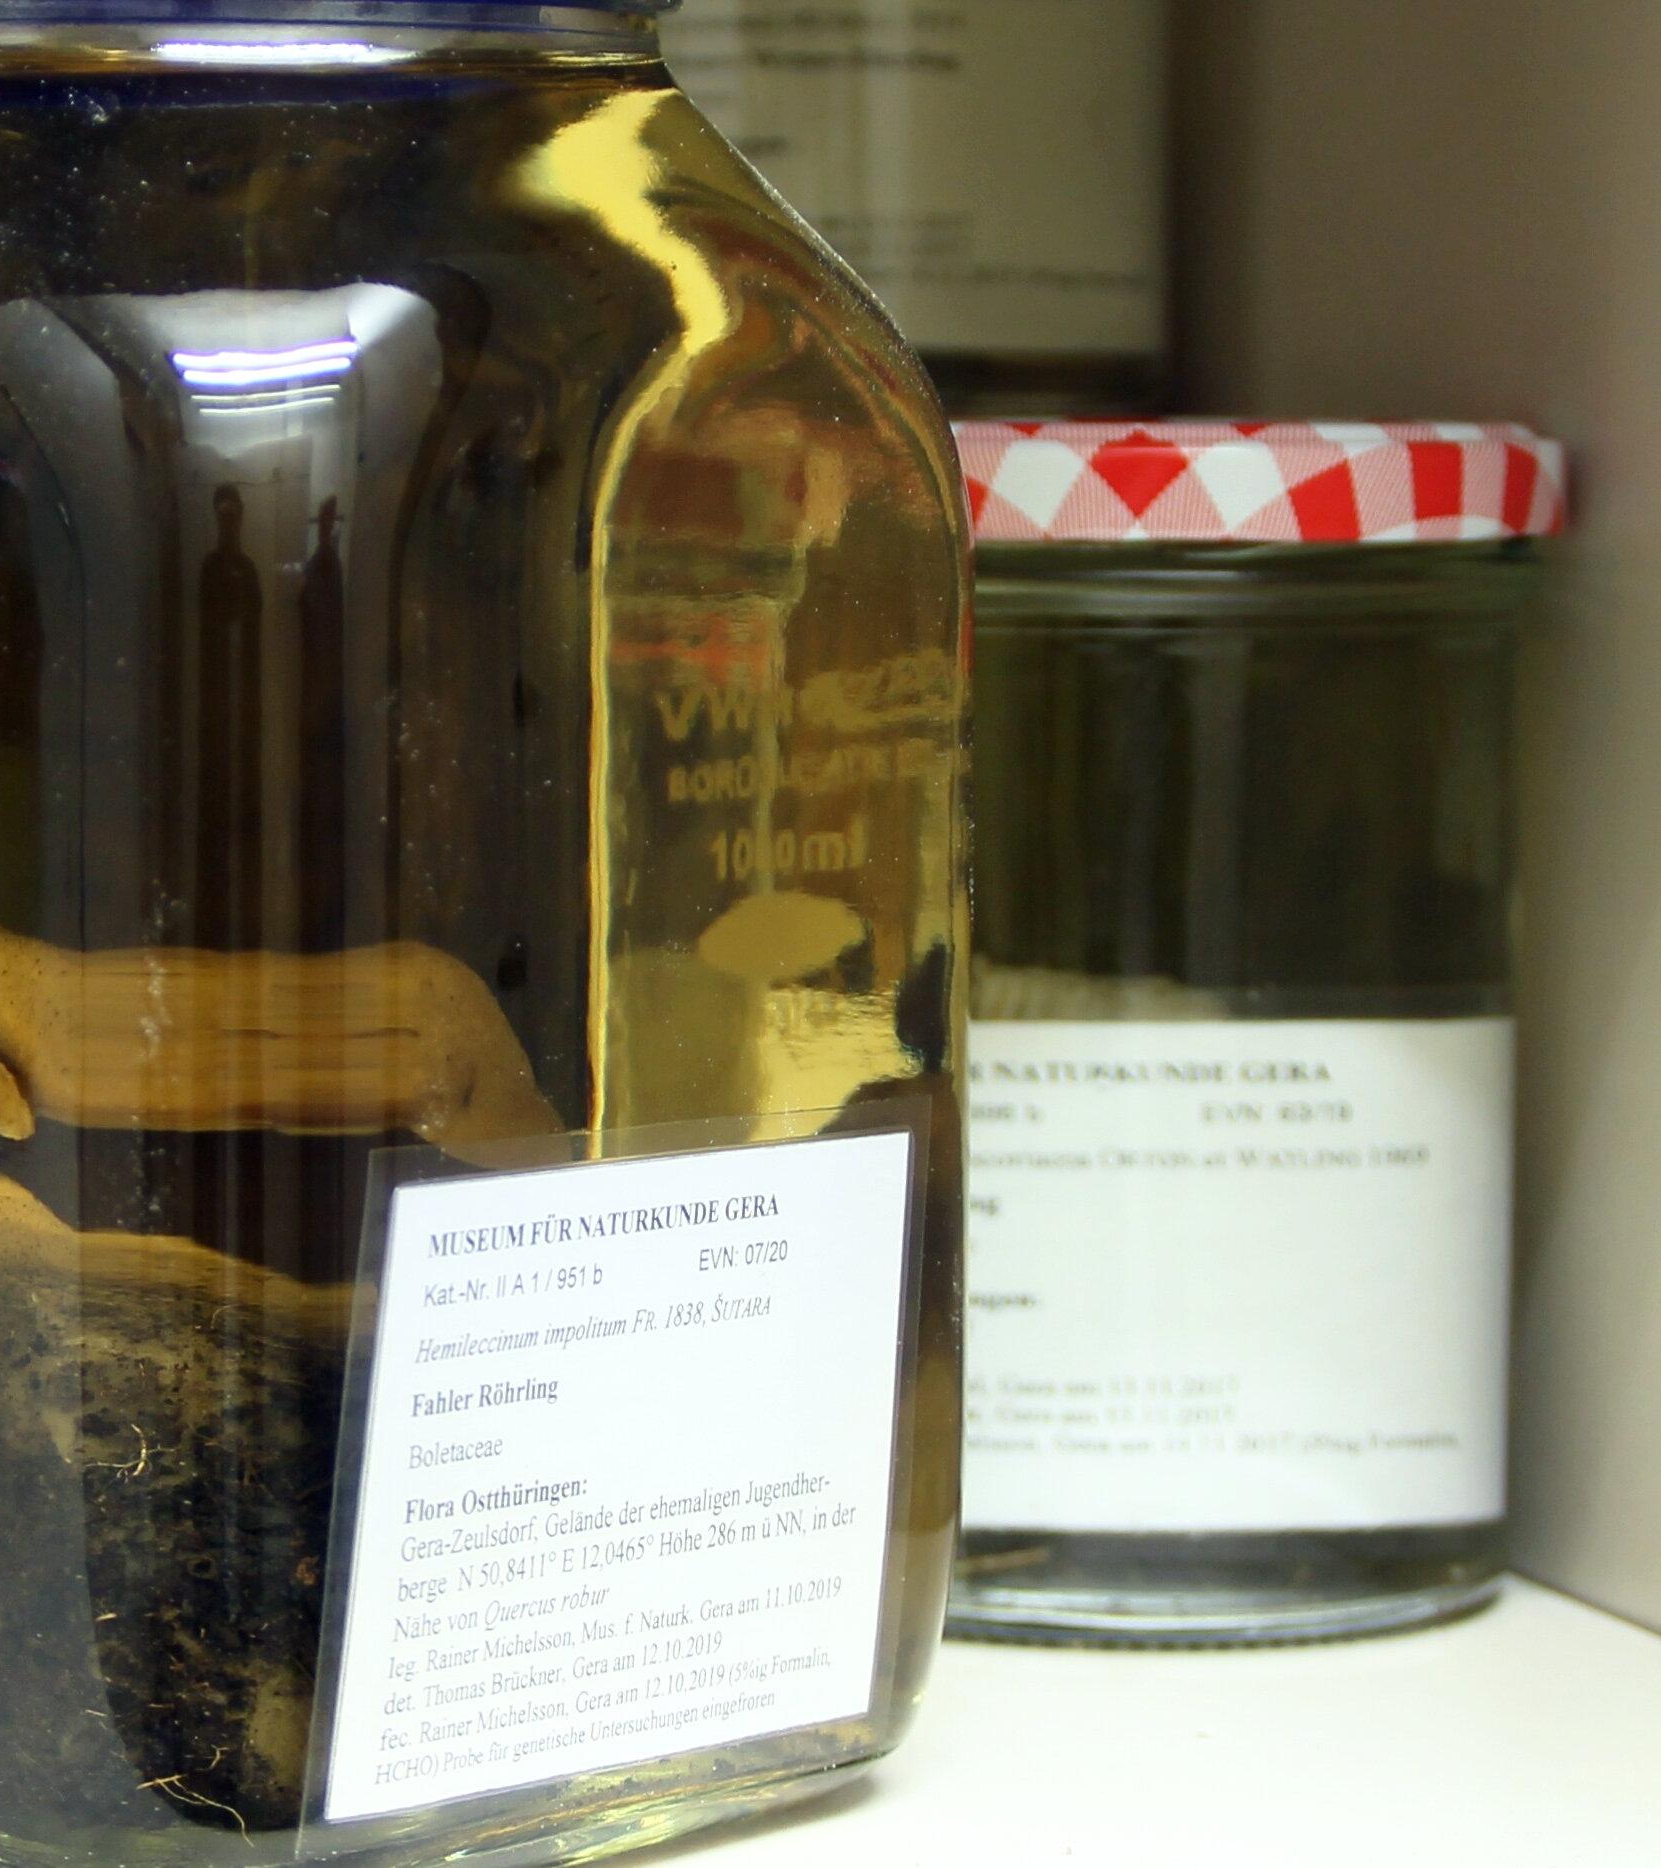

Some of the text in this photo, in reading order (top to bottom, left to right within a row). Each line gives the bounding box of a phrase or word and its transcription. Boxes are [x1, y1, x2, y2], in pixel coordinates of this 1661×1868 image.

[428, 1194, 779, 1258] MUSEUM FÜR NATURKUNDE GERA
[423, 1277, 490, 1308] Kat.-Nr.
[511, 1273, 525, 1296] A
[532, 1271, 539, 1293] 1
[544, 1269, 553, 1291] /
[557, 1265, 587, 1290] 951
[592, 1262, 603, 1285] b
[699, 1245, 739, 1271] EVN:
[745, 1239, 788, 1265] 07/20
[415, 1291, 772, 1364] Hemileccinum impolitum FR. 1838, ŠUTARA
[412, 1377, 559, 1417] Fahler Röhrling
[408, 1438, 504, 1470] Boletaceae
[400, 1471, 831, 1563] Gera-Zeulsdorf, Gelände der ehemaligen Jugendher-
[404, 1479, 588, 1524] Flora Ostthüringen:
[397, 1576, 448, 1603] berge
[458, 1565, 474, 1591] N
[478, 1550, 557, 1588] 50,8411°
[562, 1548, 575, 1573] E
[582, 1534, 654, 1572] 12,0465°
[659, 1528, 703, 1557] Höhe
[707, 1519, 736, 1548] 286
[740, 1524, 756, 1543] m
[761, 1516, 771, 1539] ü
[812, 1506, 827, 1530] in
[832, 1502, 857, 1528] der
[387, 1575, 842, 1682] leg. Rainer Michelsson, Mus. f. Naturk. Gera am 11.10.2019
[392, 1584, 610, 1643] Nähe von Quercus robur
[379, 1728, 412, 1752] fec.
[419, 1716, 473, 1744] Rainer
[476, 1700, 569, 1734] Michelsson,
[575, 1690, 611, 1714] Gera
[616, 1686, 638, 1705] am
[728, 1657, 767, 1688] (5%ig
[771, 1645, 831, 1676] Formalin,
[383, 1630, 723, 1716] det. Thomas Brückner, Gera am 12.10.2019
[374, 1692, 775, 1786] HCHO) Probe für genetische Untersuchungen eingefroren
